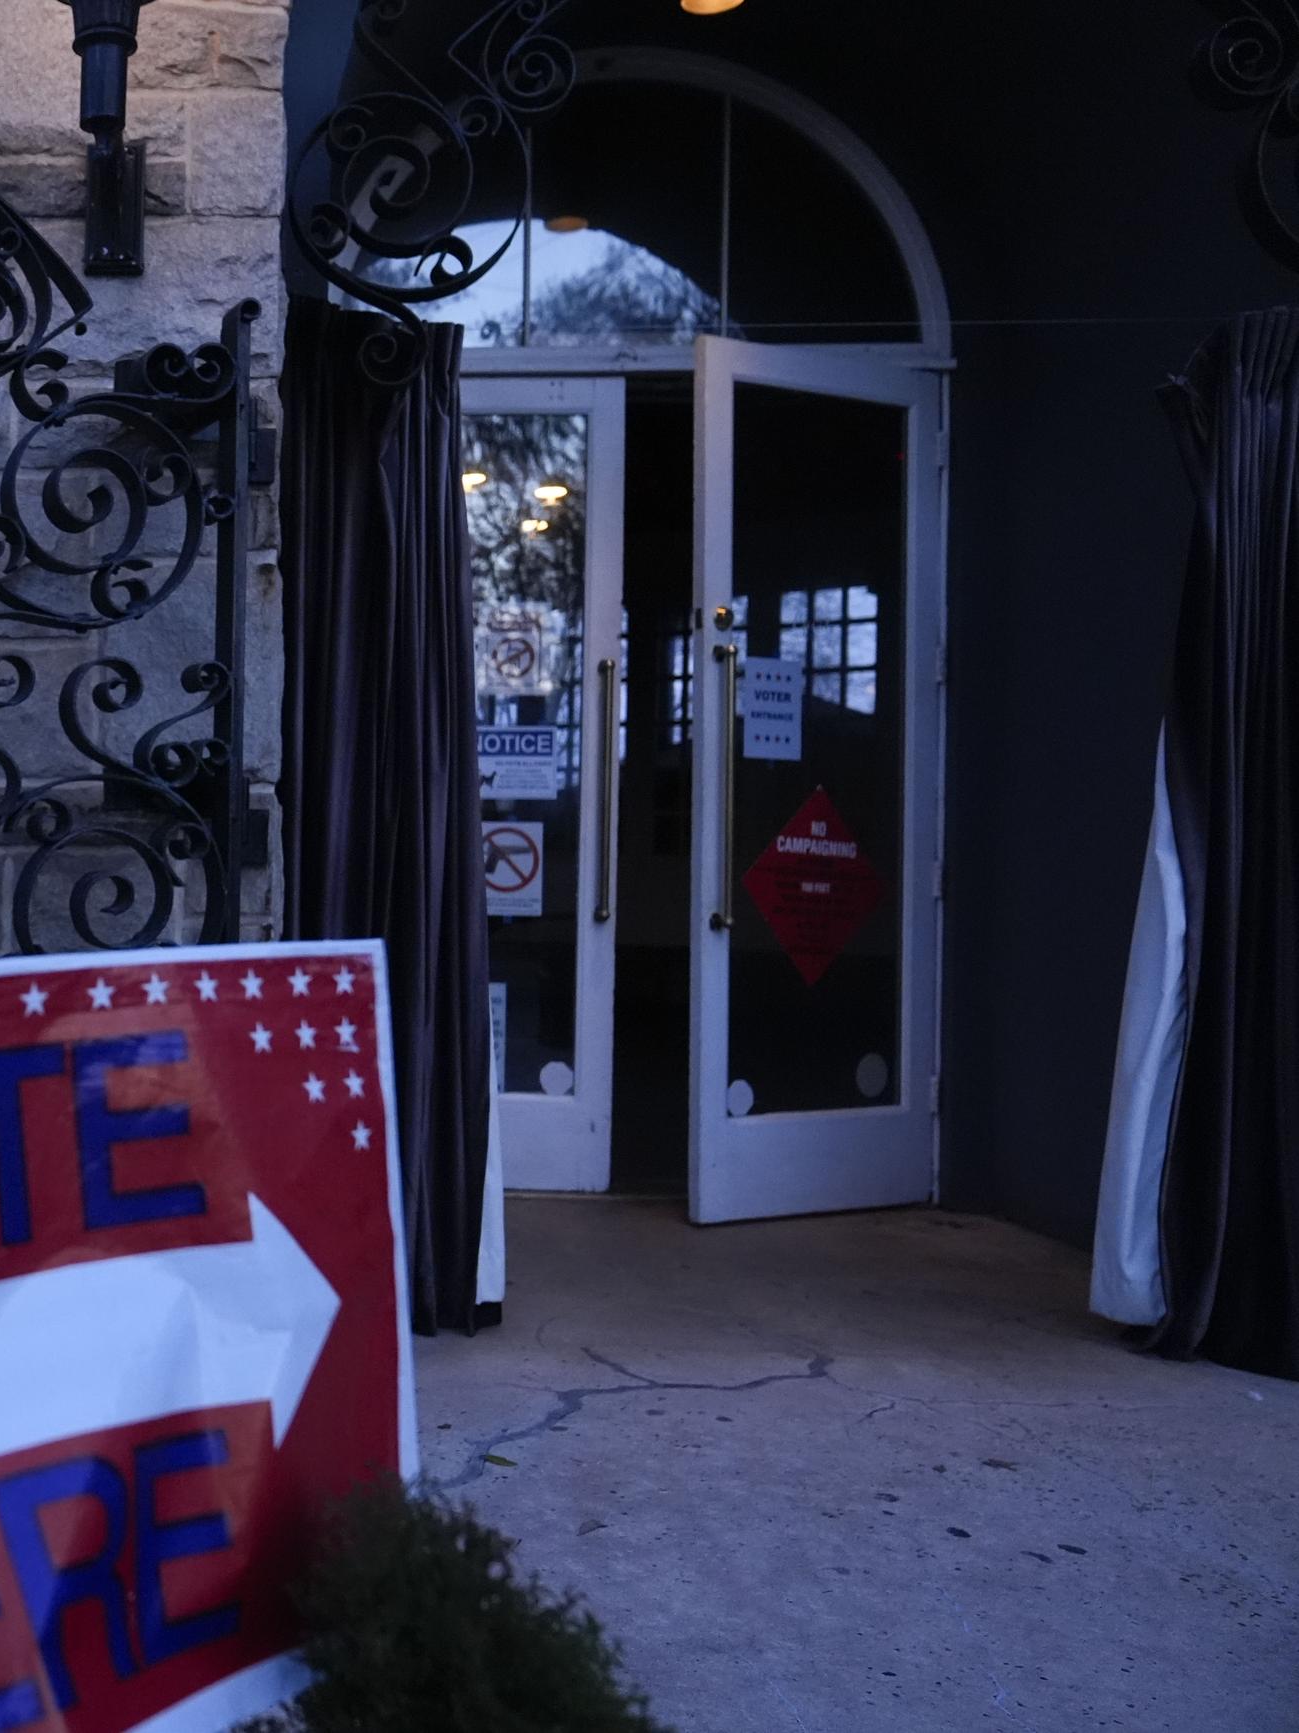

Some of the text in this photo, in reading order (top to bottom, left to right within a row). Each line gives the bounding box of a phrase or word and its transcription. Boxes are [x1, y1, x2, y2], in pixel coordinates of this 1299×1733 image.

[755, 690, 792, 702] VOTER
[751, 711, 793, 722] ENTRANCE
[811, 820, 827, 838] NO
[776, 835, 858, 859] CAMPAIGNING
